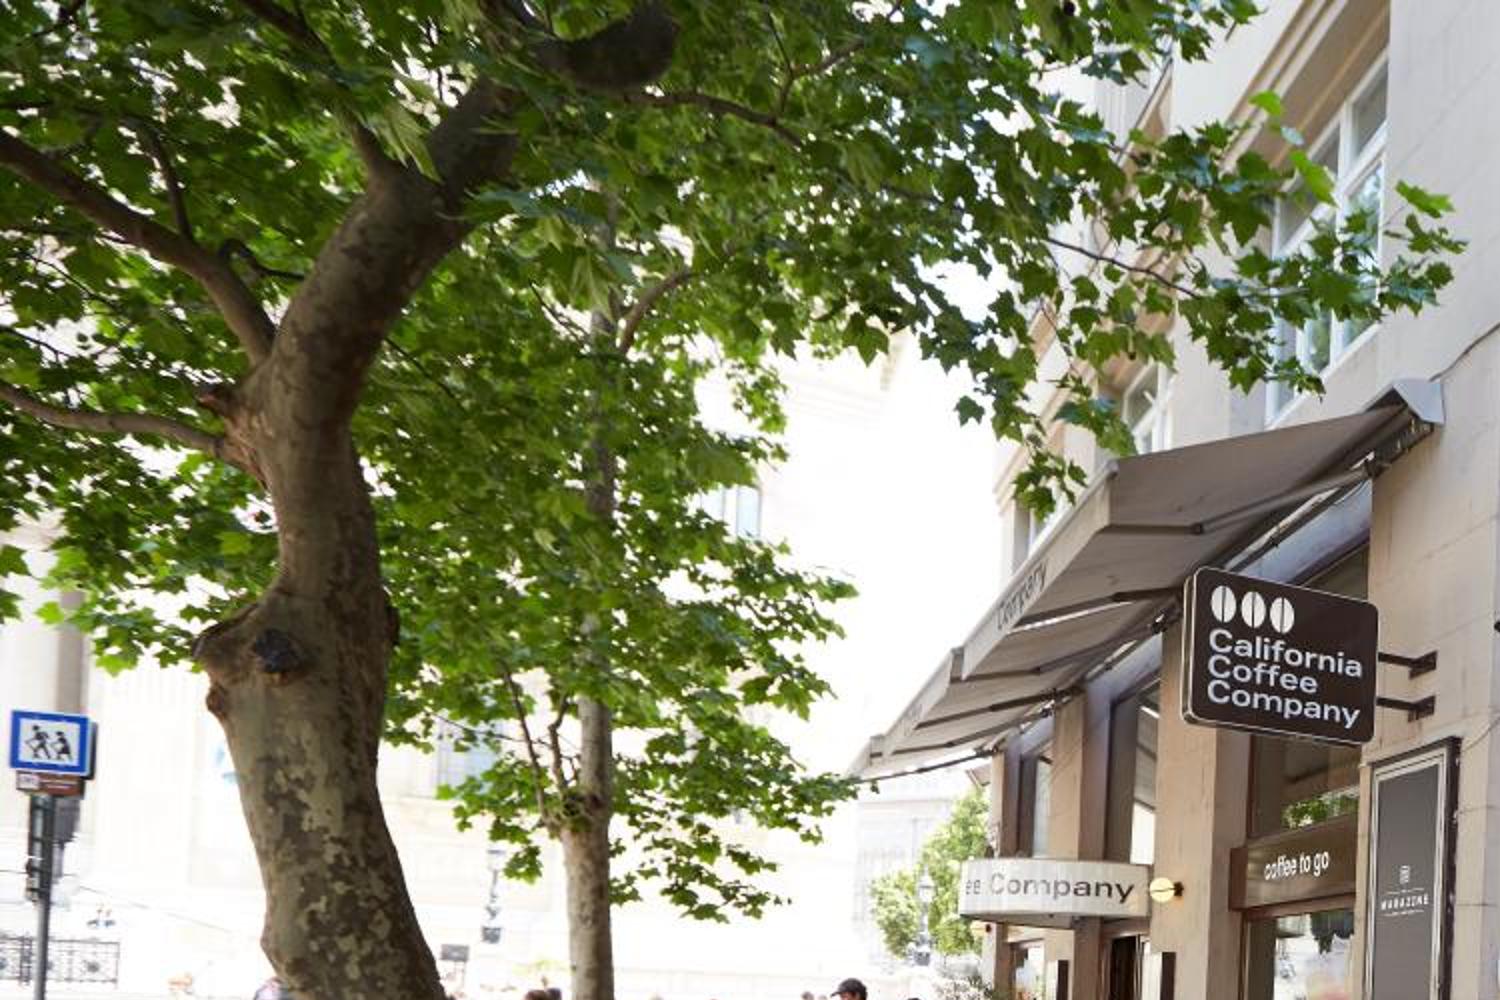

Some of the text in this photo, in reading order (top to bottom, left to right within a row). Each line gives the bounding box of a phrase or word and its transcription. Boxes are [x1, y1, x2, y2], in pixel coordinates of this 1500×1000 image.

[1209, 628, 1362, 678] California
[1208, 655, 1319, 694] Coffee
[1207, 680, 1361, 729] Company
[1264, 851, 1330, 880] coffee to go
[990, 872, 1135, 903] Company
